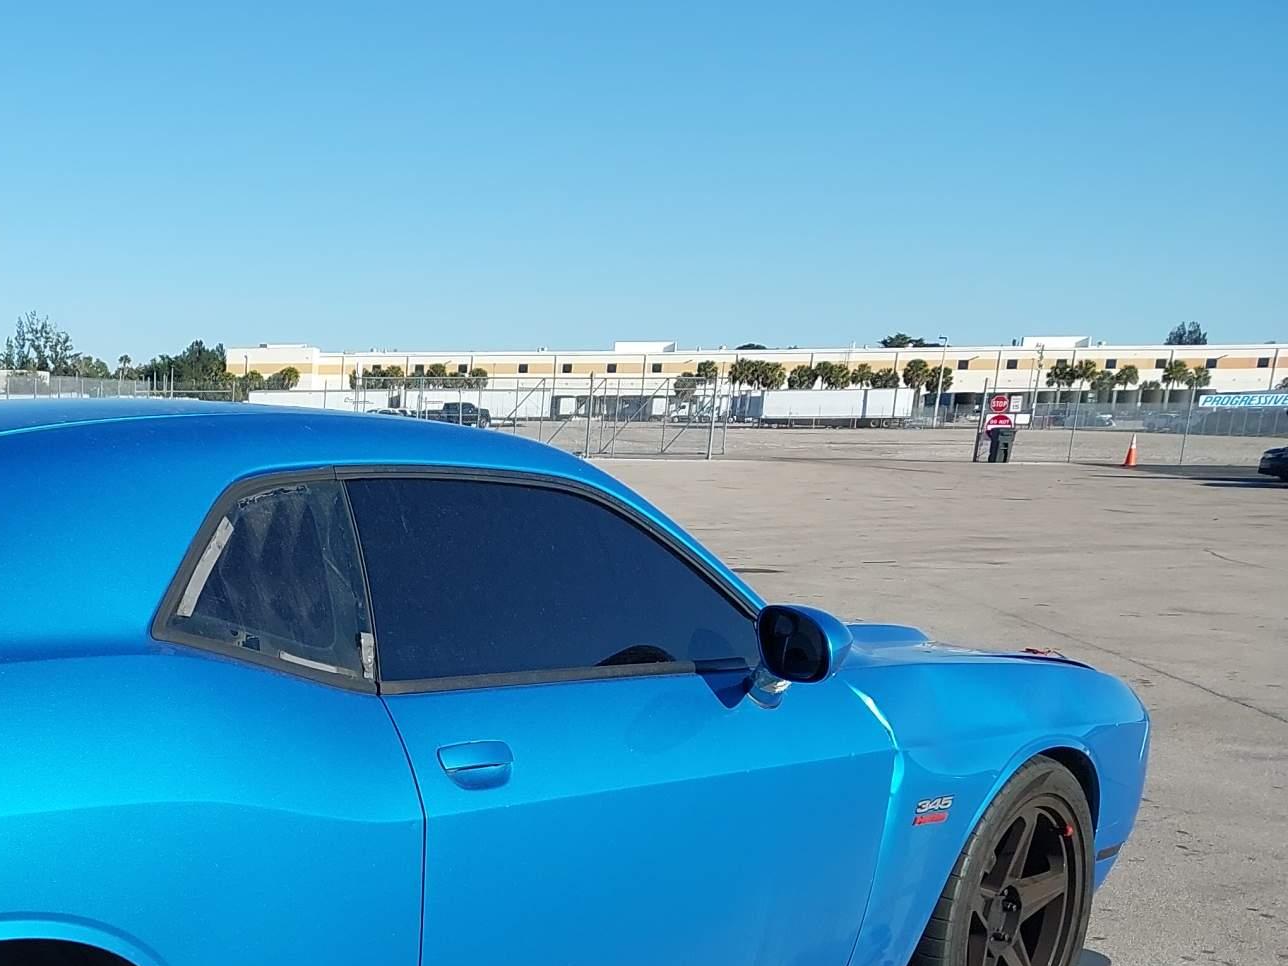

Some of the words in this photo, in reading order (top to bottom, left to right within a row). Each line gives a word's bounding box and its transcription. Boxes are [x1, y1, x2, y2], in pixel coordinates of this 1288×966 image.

[992, 400, 1008, 408] STOP
[1202, 395, 1288, 406] PROGRESSIVE
[916, 795, 954, 814] 345
